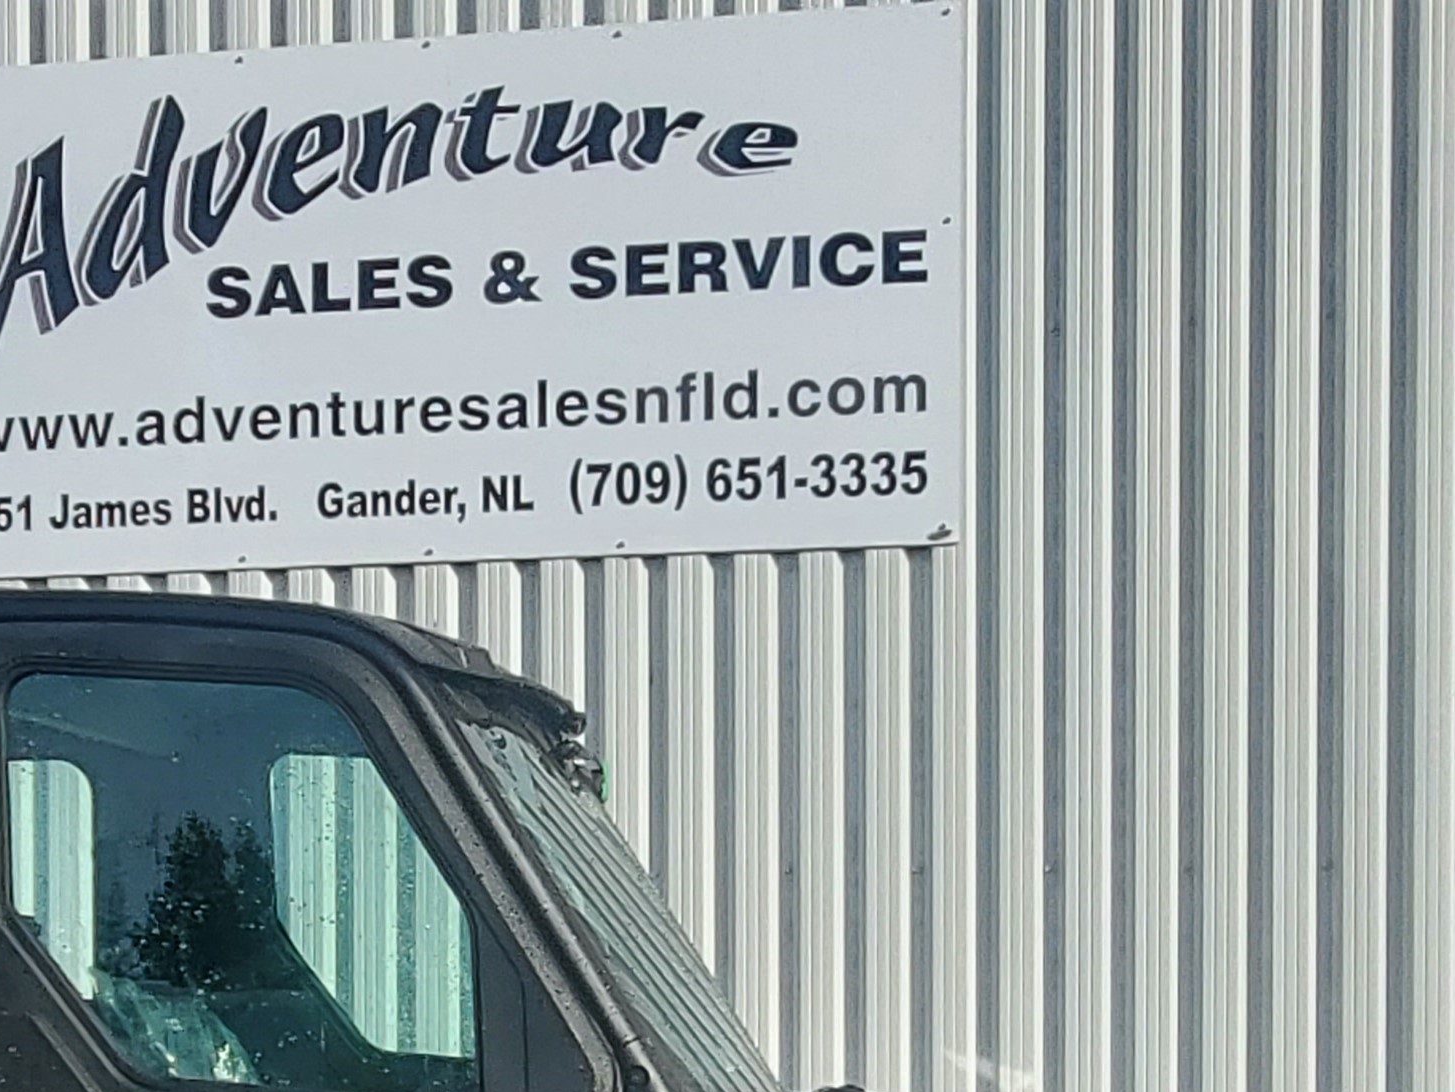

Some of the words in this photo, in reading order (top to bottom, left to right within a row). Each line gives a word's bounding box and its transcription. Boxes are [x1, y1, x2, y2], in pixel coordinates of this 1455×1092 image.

[206, 254, 453, 318] SALES
[484, 250, 542, 304] &
[570, 229, 929, 300] SERVICE
[49, 491, 172, 531] James
[187, 486, 278, 525] Blvd.
[317, 480, 467, 524] Gander,
[483, 475, 535, 513] NL
[569, 454, 687, 515] (709)
[706, 451, 929, 503] 651-3335
